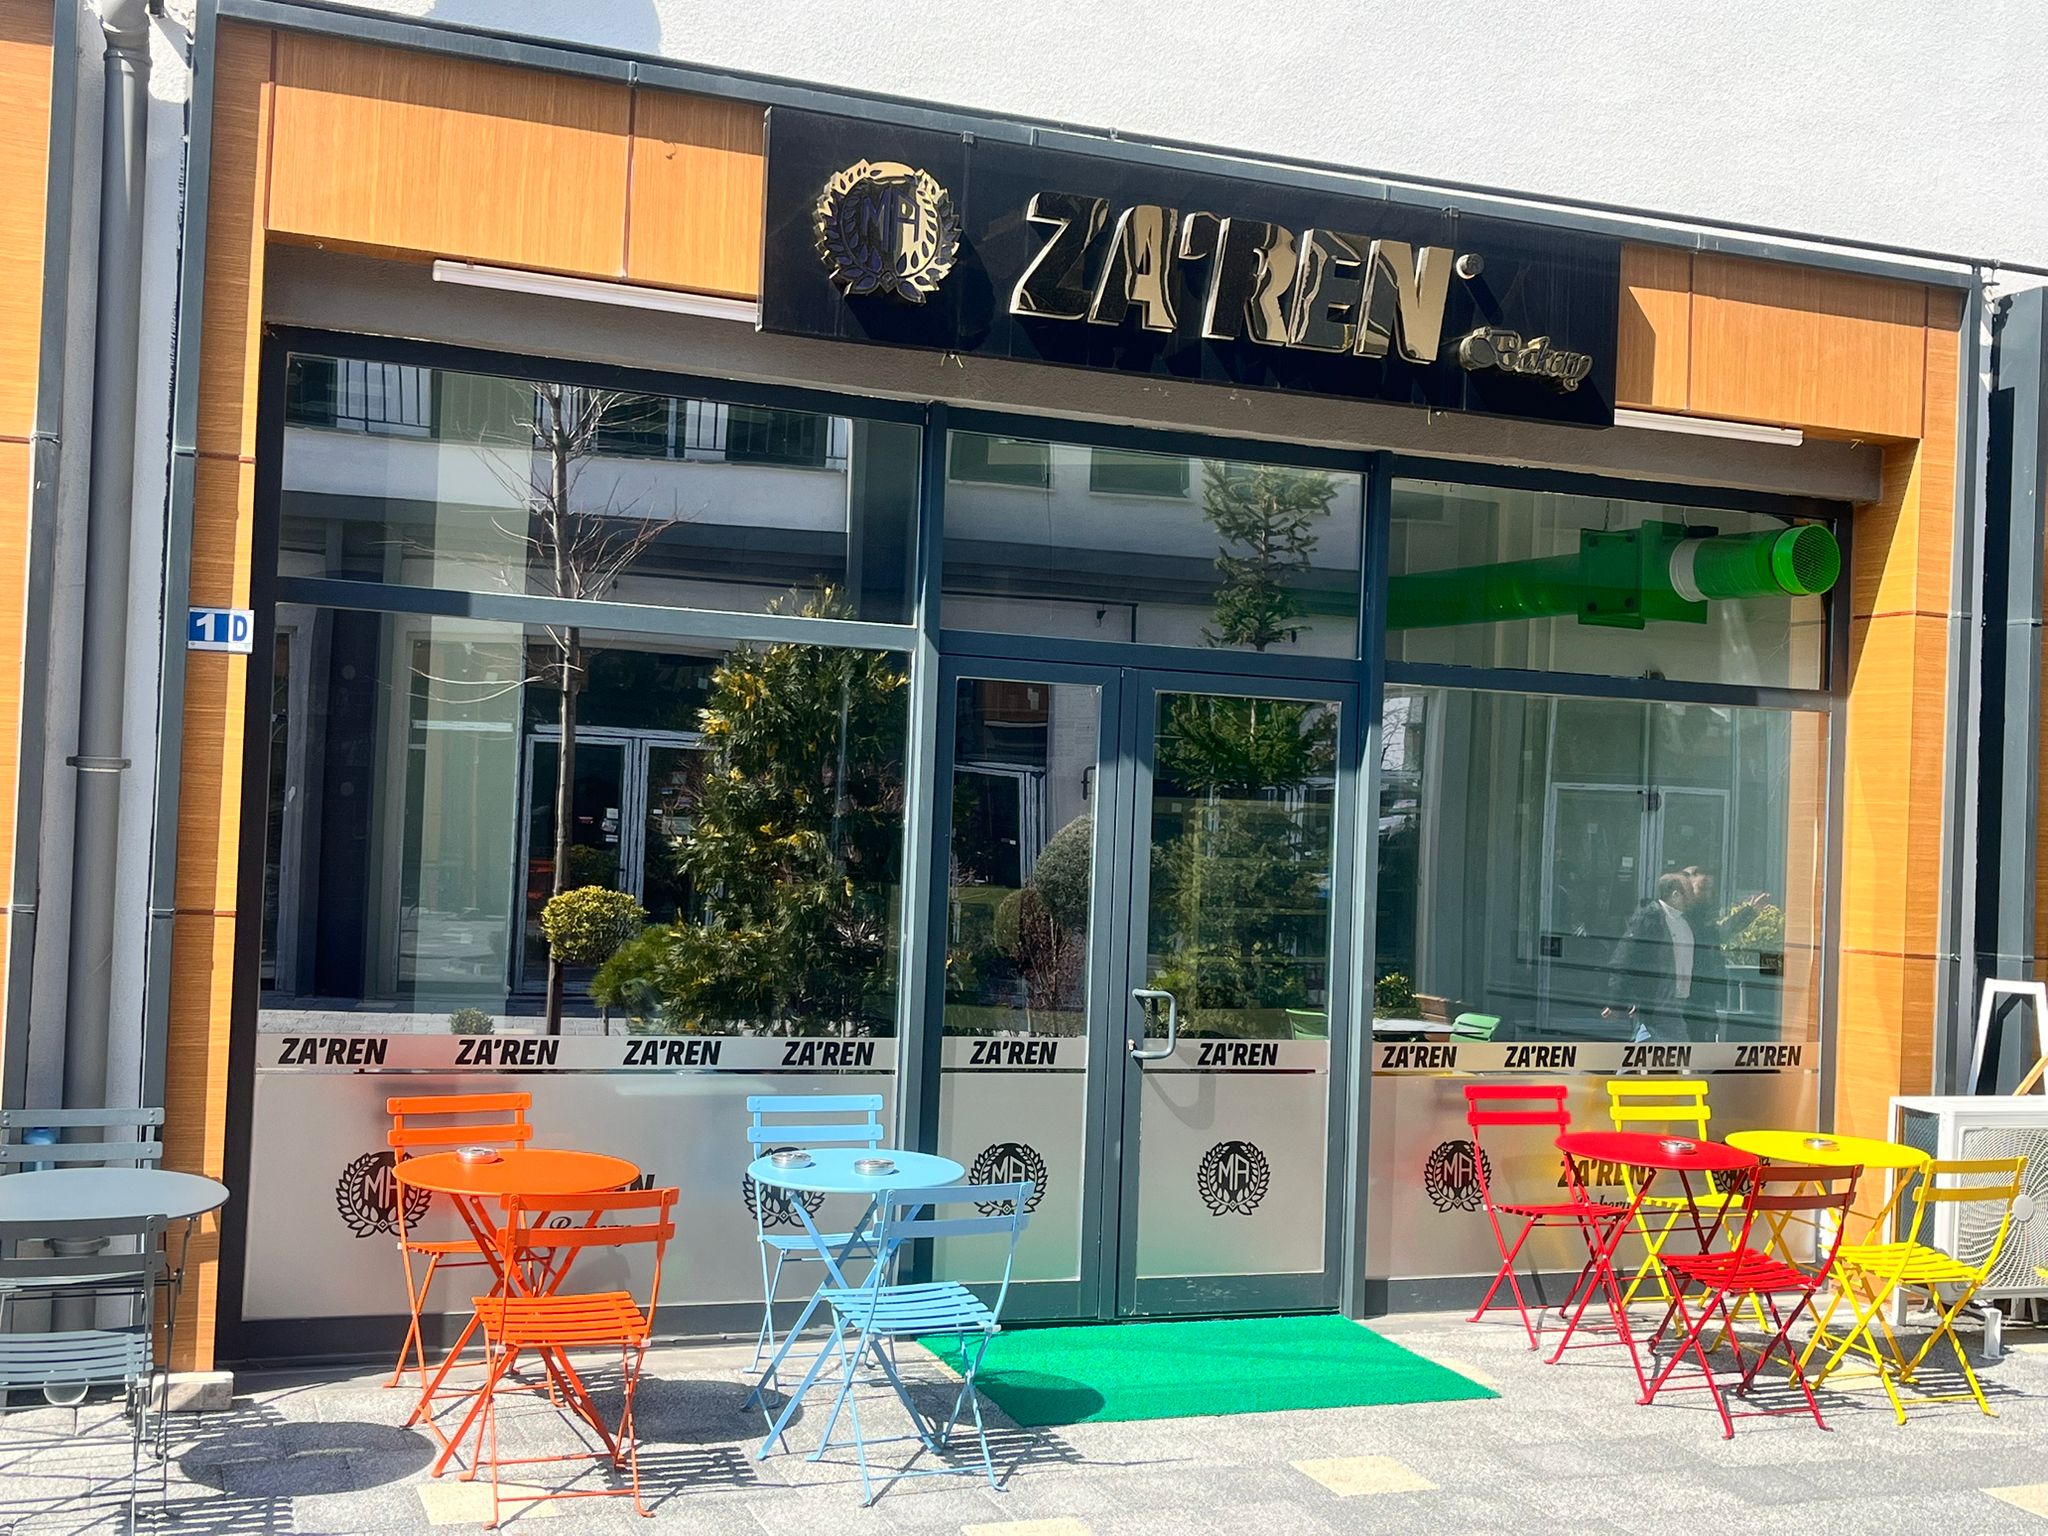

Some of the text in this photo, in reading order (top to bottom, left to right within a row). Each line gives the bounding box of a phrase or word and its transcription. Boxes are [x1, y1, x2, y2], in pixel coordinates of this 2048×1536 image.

[1009, 192, 1455, 365] ZA'REN
[196, 613, 248, 642] 1 D
[278, 1038, 875, 1067] ZA'REN ZA'REN ZA'REN ZA'REN
[969, 1041, 1057, 1065] ZA'REN
[1197, 1042, 1279, 1067] ZA'REN
[1381, 1045, 1802, 1068] ZA'REN ZA'REN ZA'REN ZA'REN
